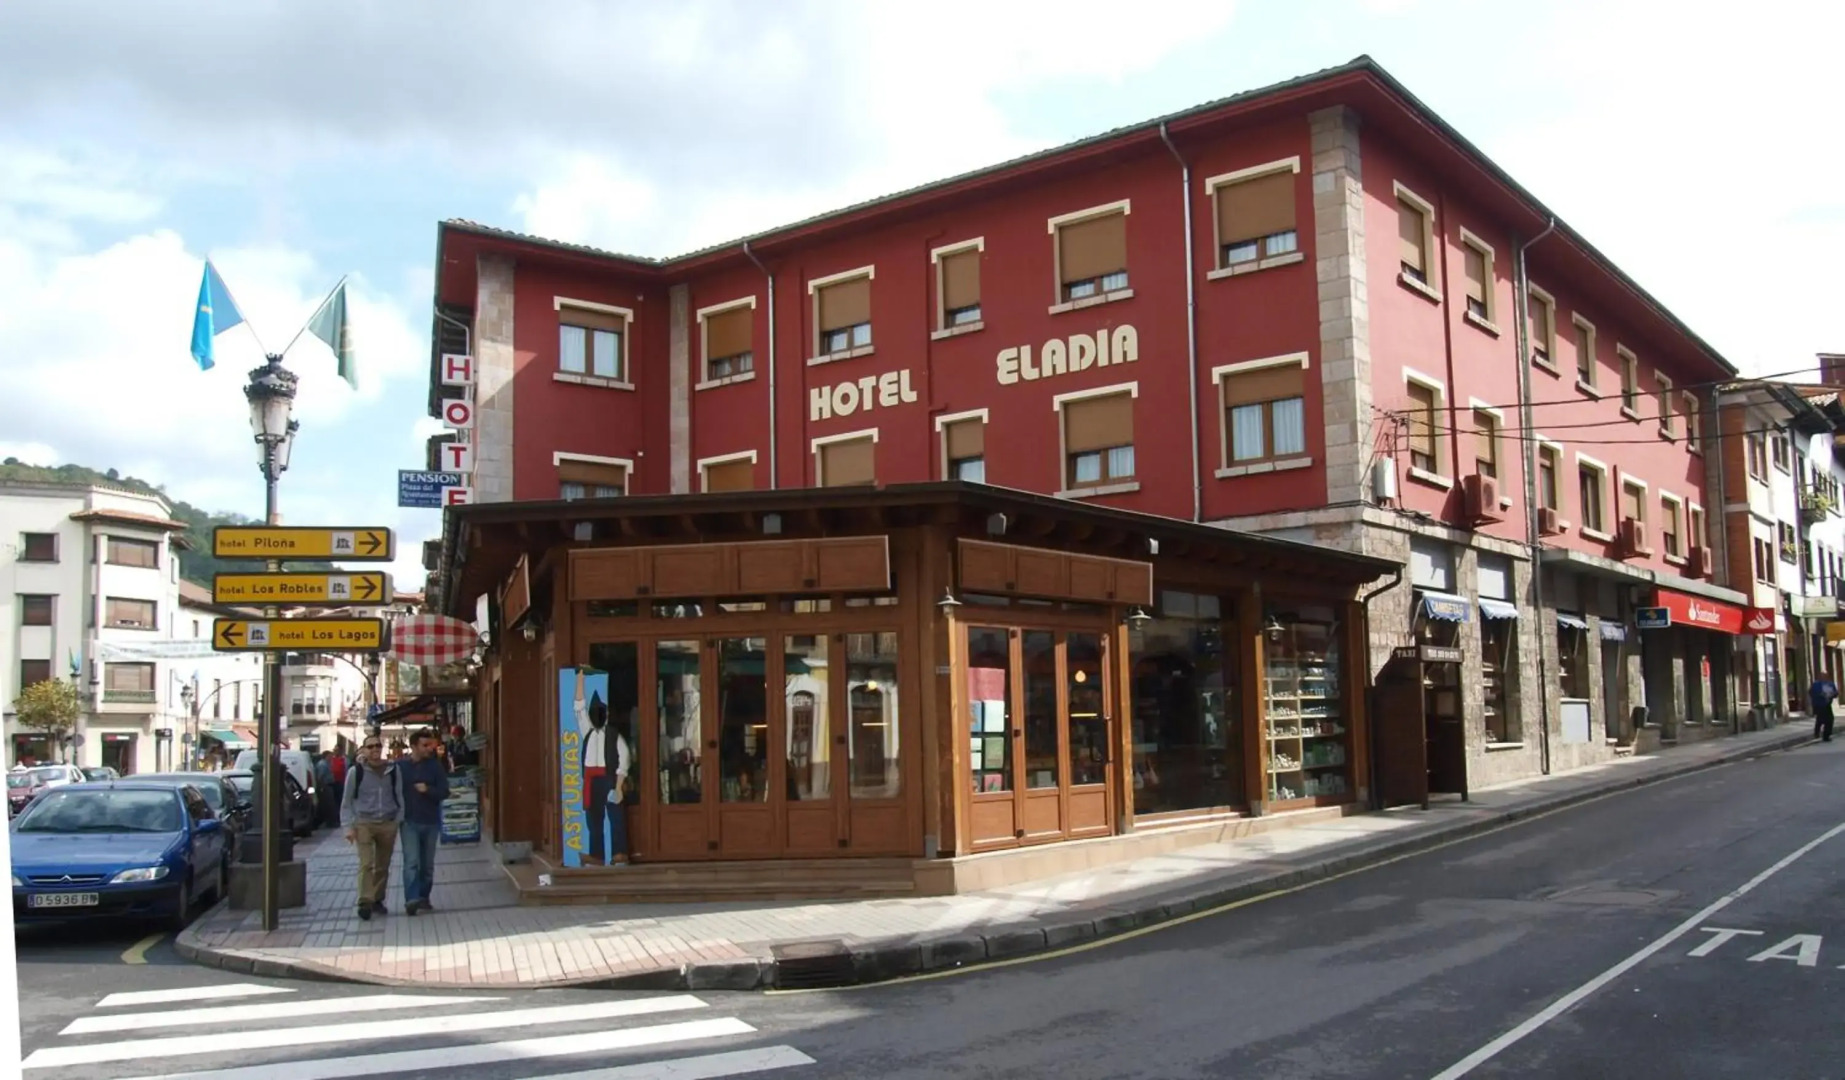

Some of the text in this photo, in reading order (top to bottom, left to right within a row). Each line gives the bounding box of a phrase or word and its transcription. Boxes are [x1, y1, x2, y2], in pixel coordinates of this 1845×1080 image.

[810, 324, 1139, 422] HOTEL ELADIA
[401, 472, 458, 484] PENSION
[219, 537, 296, 549] hotel Piloña
[219, 583, 323, 594] hotel Los Robles
[279, 629, 376, 642] hotel Los Lagos
[562, 730, 583, 850] ASTURIAS
[45, 894, 79, 906] 5936
[1686, 926, 1845, 969] TA
